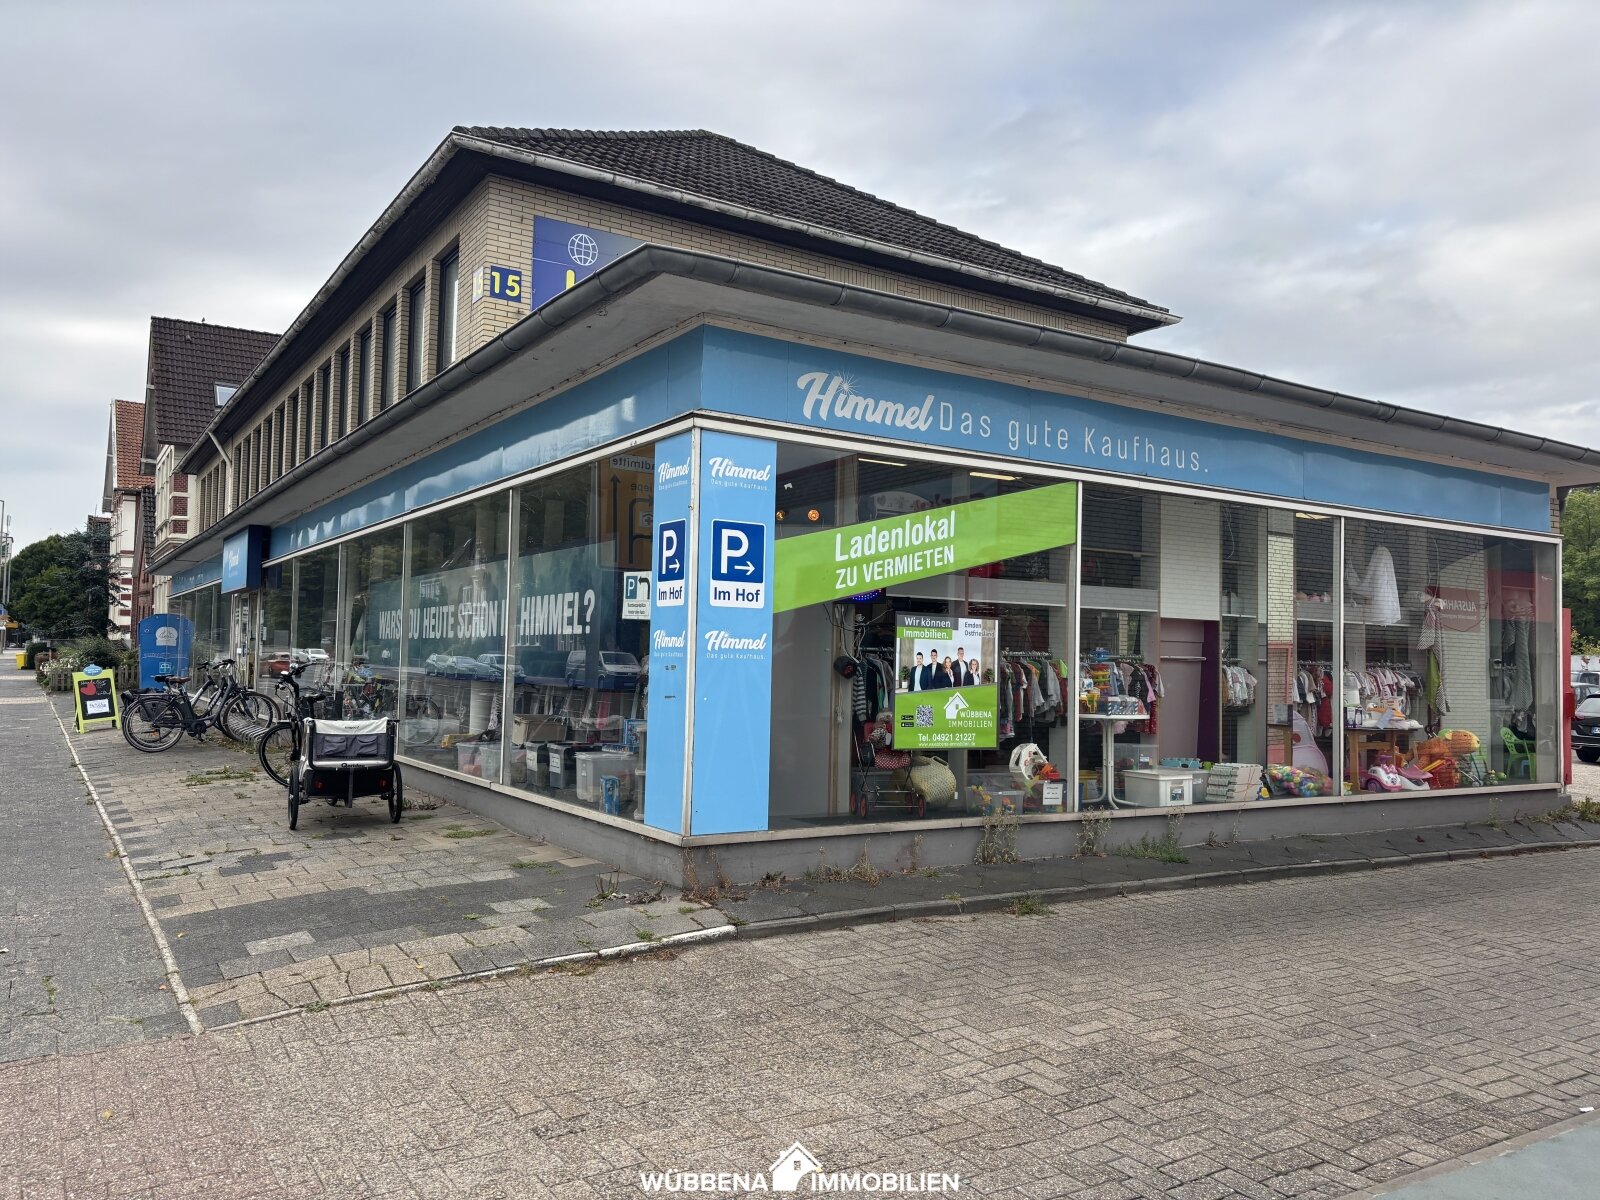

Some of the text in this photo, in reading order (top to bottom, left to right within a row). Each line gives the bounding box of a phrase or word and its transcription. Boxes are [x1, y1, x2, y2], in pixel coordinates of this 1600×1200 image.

[491, 271, 520, 297] 15
[797, 371, 1210, 473] Himmel Das gute Kaufhaus.
[658, 457, 690, 484] Himmel
[708, 456, 771, 482] Himmel
[835, 510, 956, 562] Ladenlokal
[661, 529, 677, 575] P
[720, 528, 749, 574] P
[835, 545, 954, 590] ZU VERMIETEN
[628, 579, 635, 597] P
[658, 586, 683, 601] Im Hof
[713, 587, 761, 602] Im Hof
[379, 608, 402, 640] WARS
[408, 608, 421, 640] DU
[422, 604, 455, 639] HEUTE
[457, 599, 499, 639] SCHON
[519, 588, 596, 637] HIMMEL?
[904, 617, 951, 628] Wir können
[903, 628, 949, 639] Immobilien.
[964, 621, 982, 629] Emden
[653, 629, 686, 650] Himmel
[704, 630, 768, 652] Himmel
[948, 720, 993, 728] IMMOBILIEN
[959, 709, 992, 718] WÜBBENA
[918, 733, 976, 741] Tel. 04921 21227
